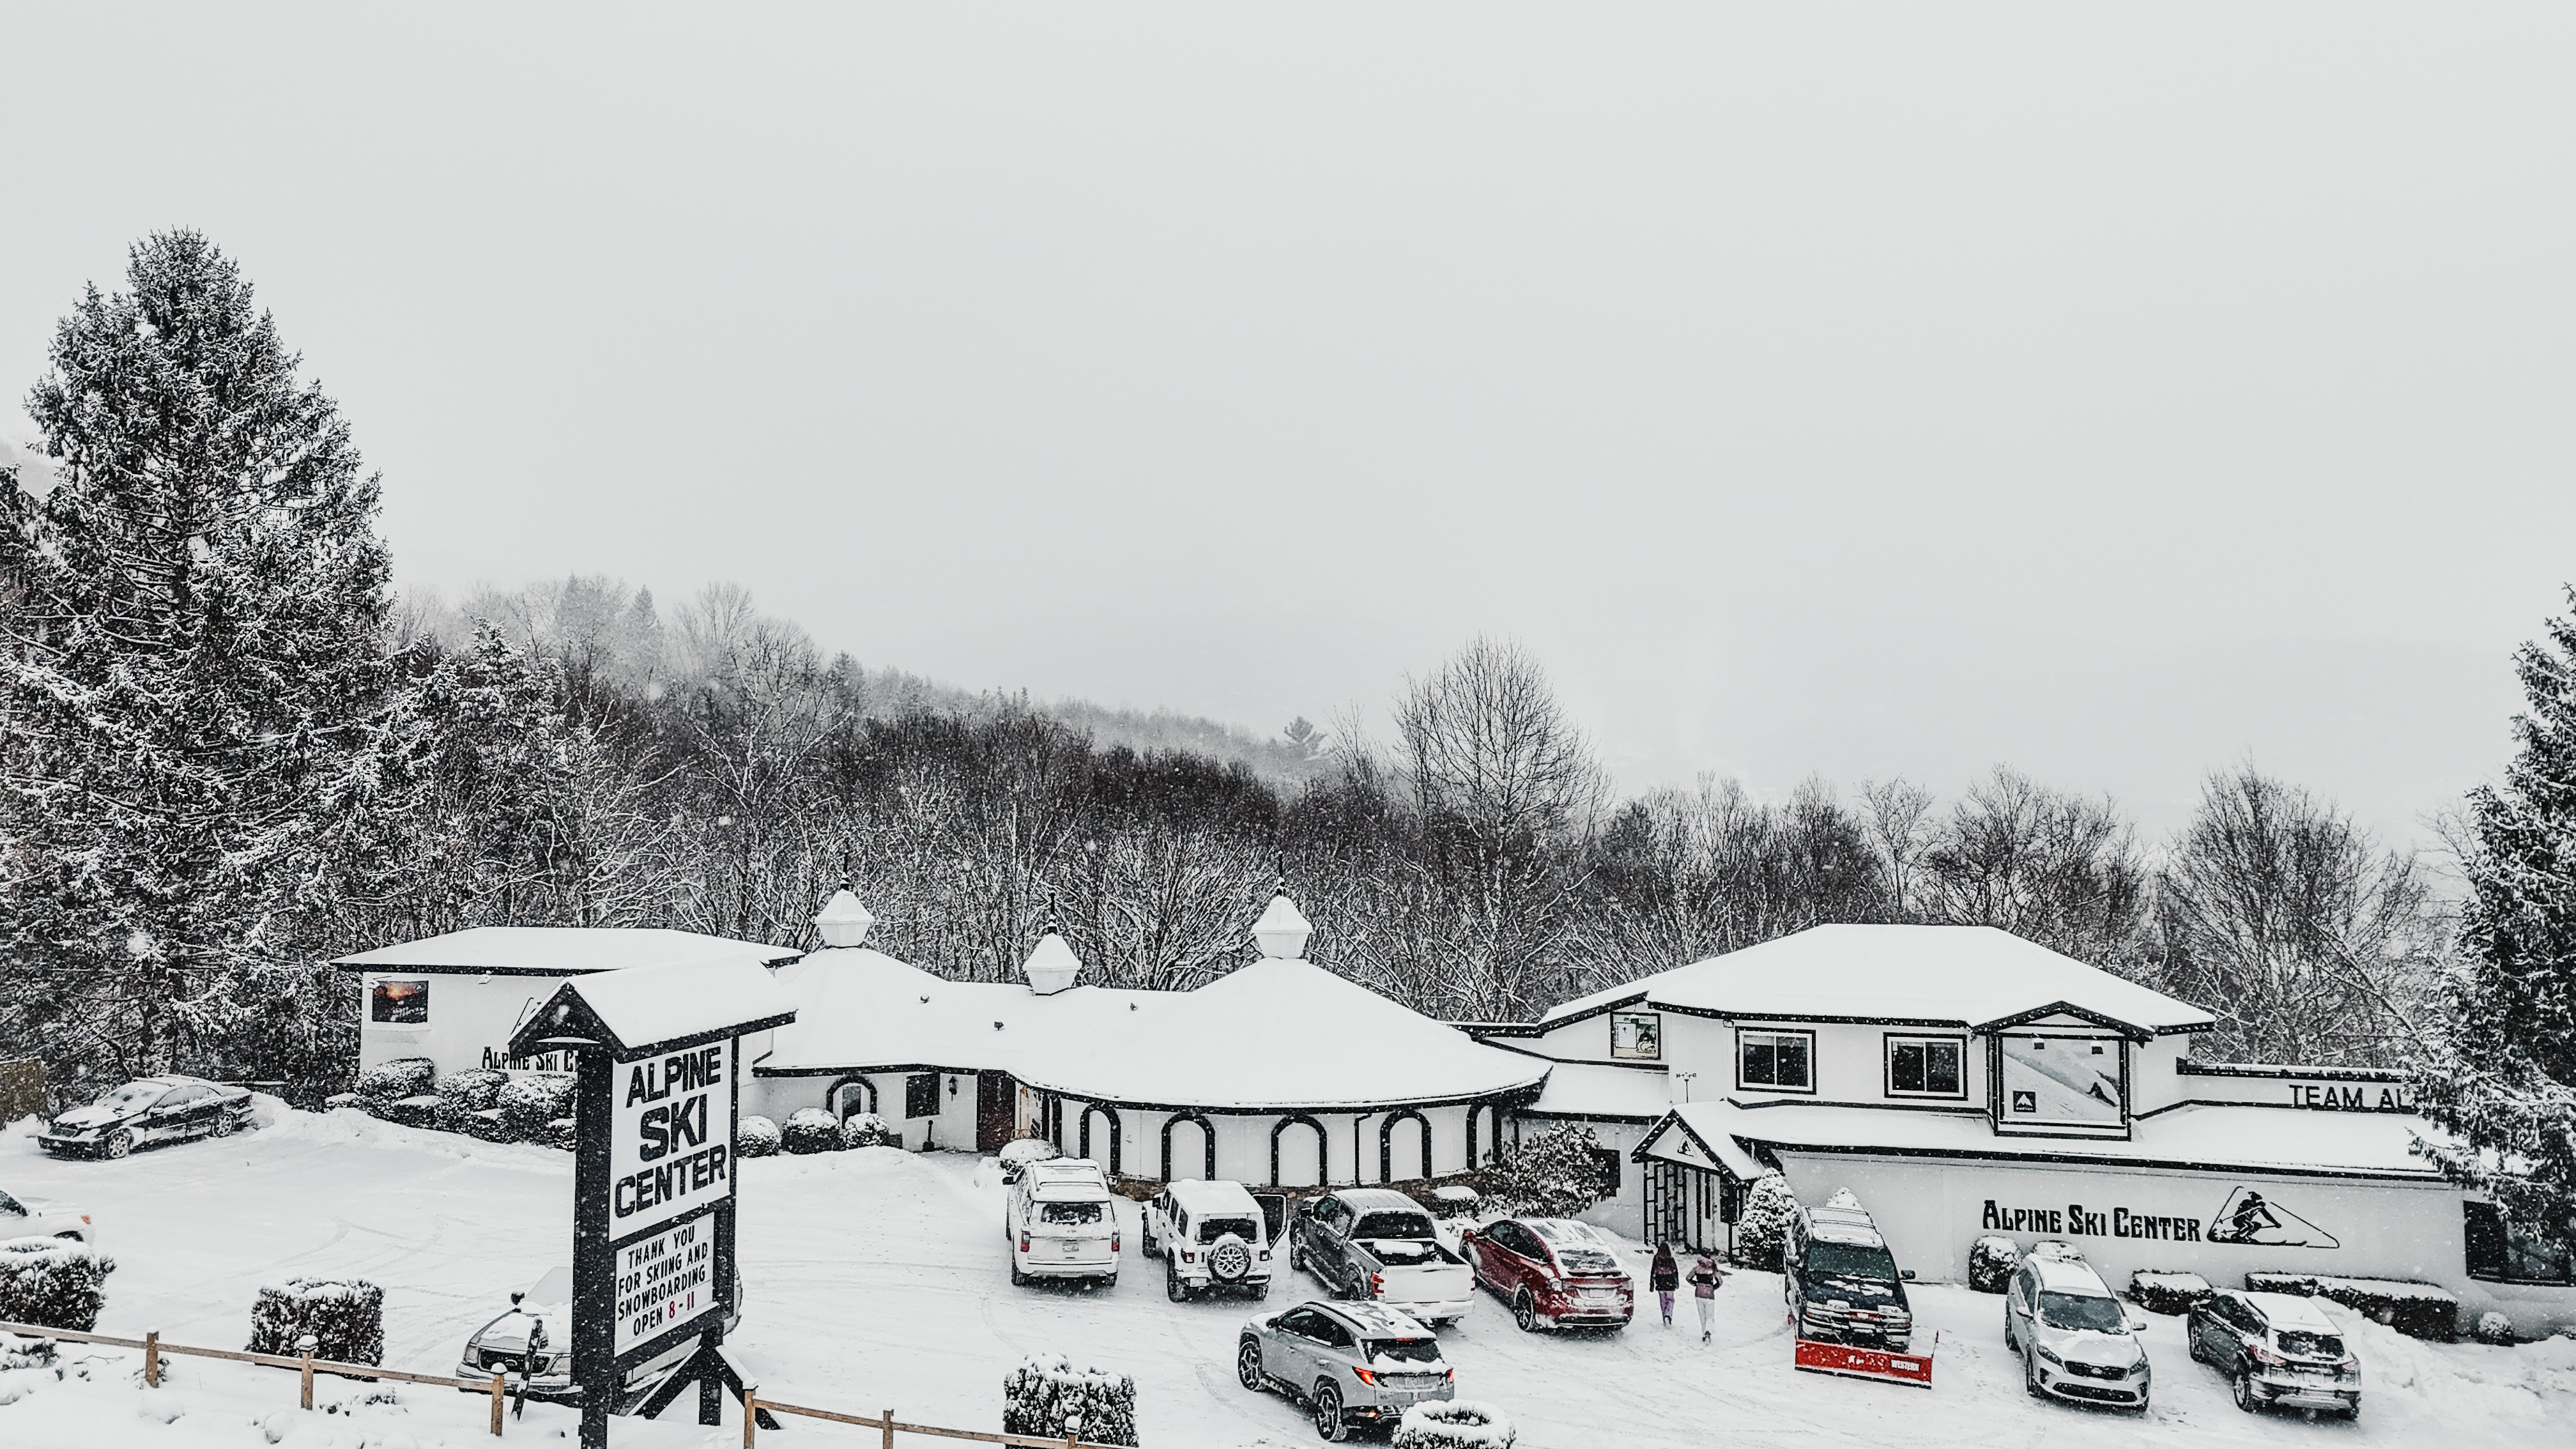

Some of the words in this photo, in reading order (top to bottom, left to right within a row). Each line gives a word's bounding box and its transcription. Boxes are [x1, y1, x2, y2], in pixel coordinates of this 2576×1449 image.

[626, 1046, 721, 1108] ALPINE
[2288, 1084, 2363, 1109] TEAM
[640, 1093, 707, 1162] SKI
[615, 1144, 727, 1218] CENTER
[1982, 1200, 2062, 1233] ALPINE
[2068, 1204, 2107, 1236] SKI
[2113, 1208, 2201, 1242] CENTER
[618, 1271, 641, 1297] FOR
[647, 1253, 682, 1285] SKIING
[687, 1242, 708, 1266] AND
[628, 1238, 665, 1269] THANK
[673, 1225, 694, 1249] YOU
[618, 1264, 705, 1321] SNOWBOARDING
[633, 1307, 663, 1336] OPEN
[669, 1301, 675, 1319] 8
[687, 1291, 694, 1310] 11
[1891, 1360, 1919, 1372] WESTERN
